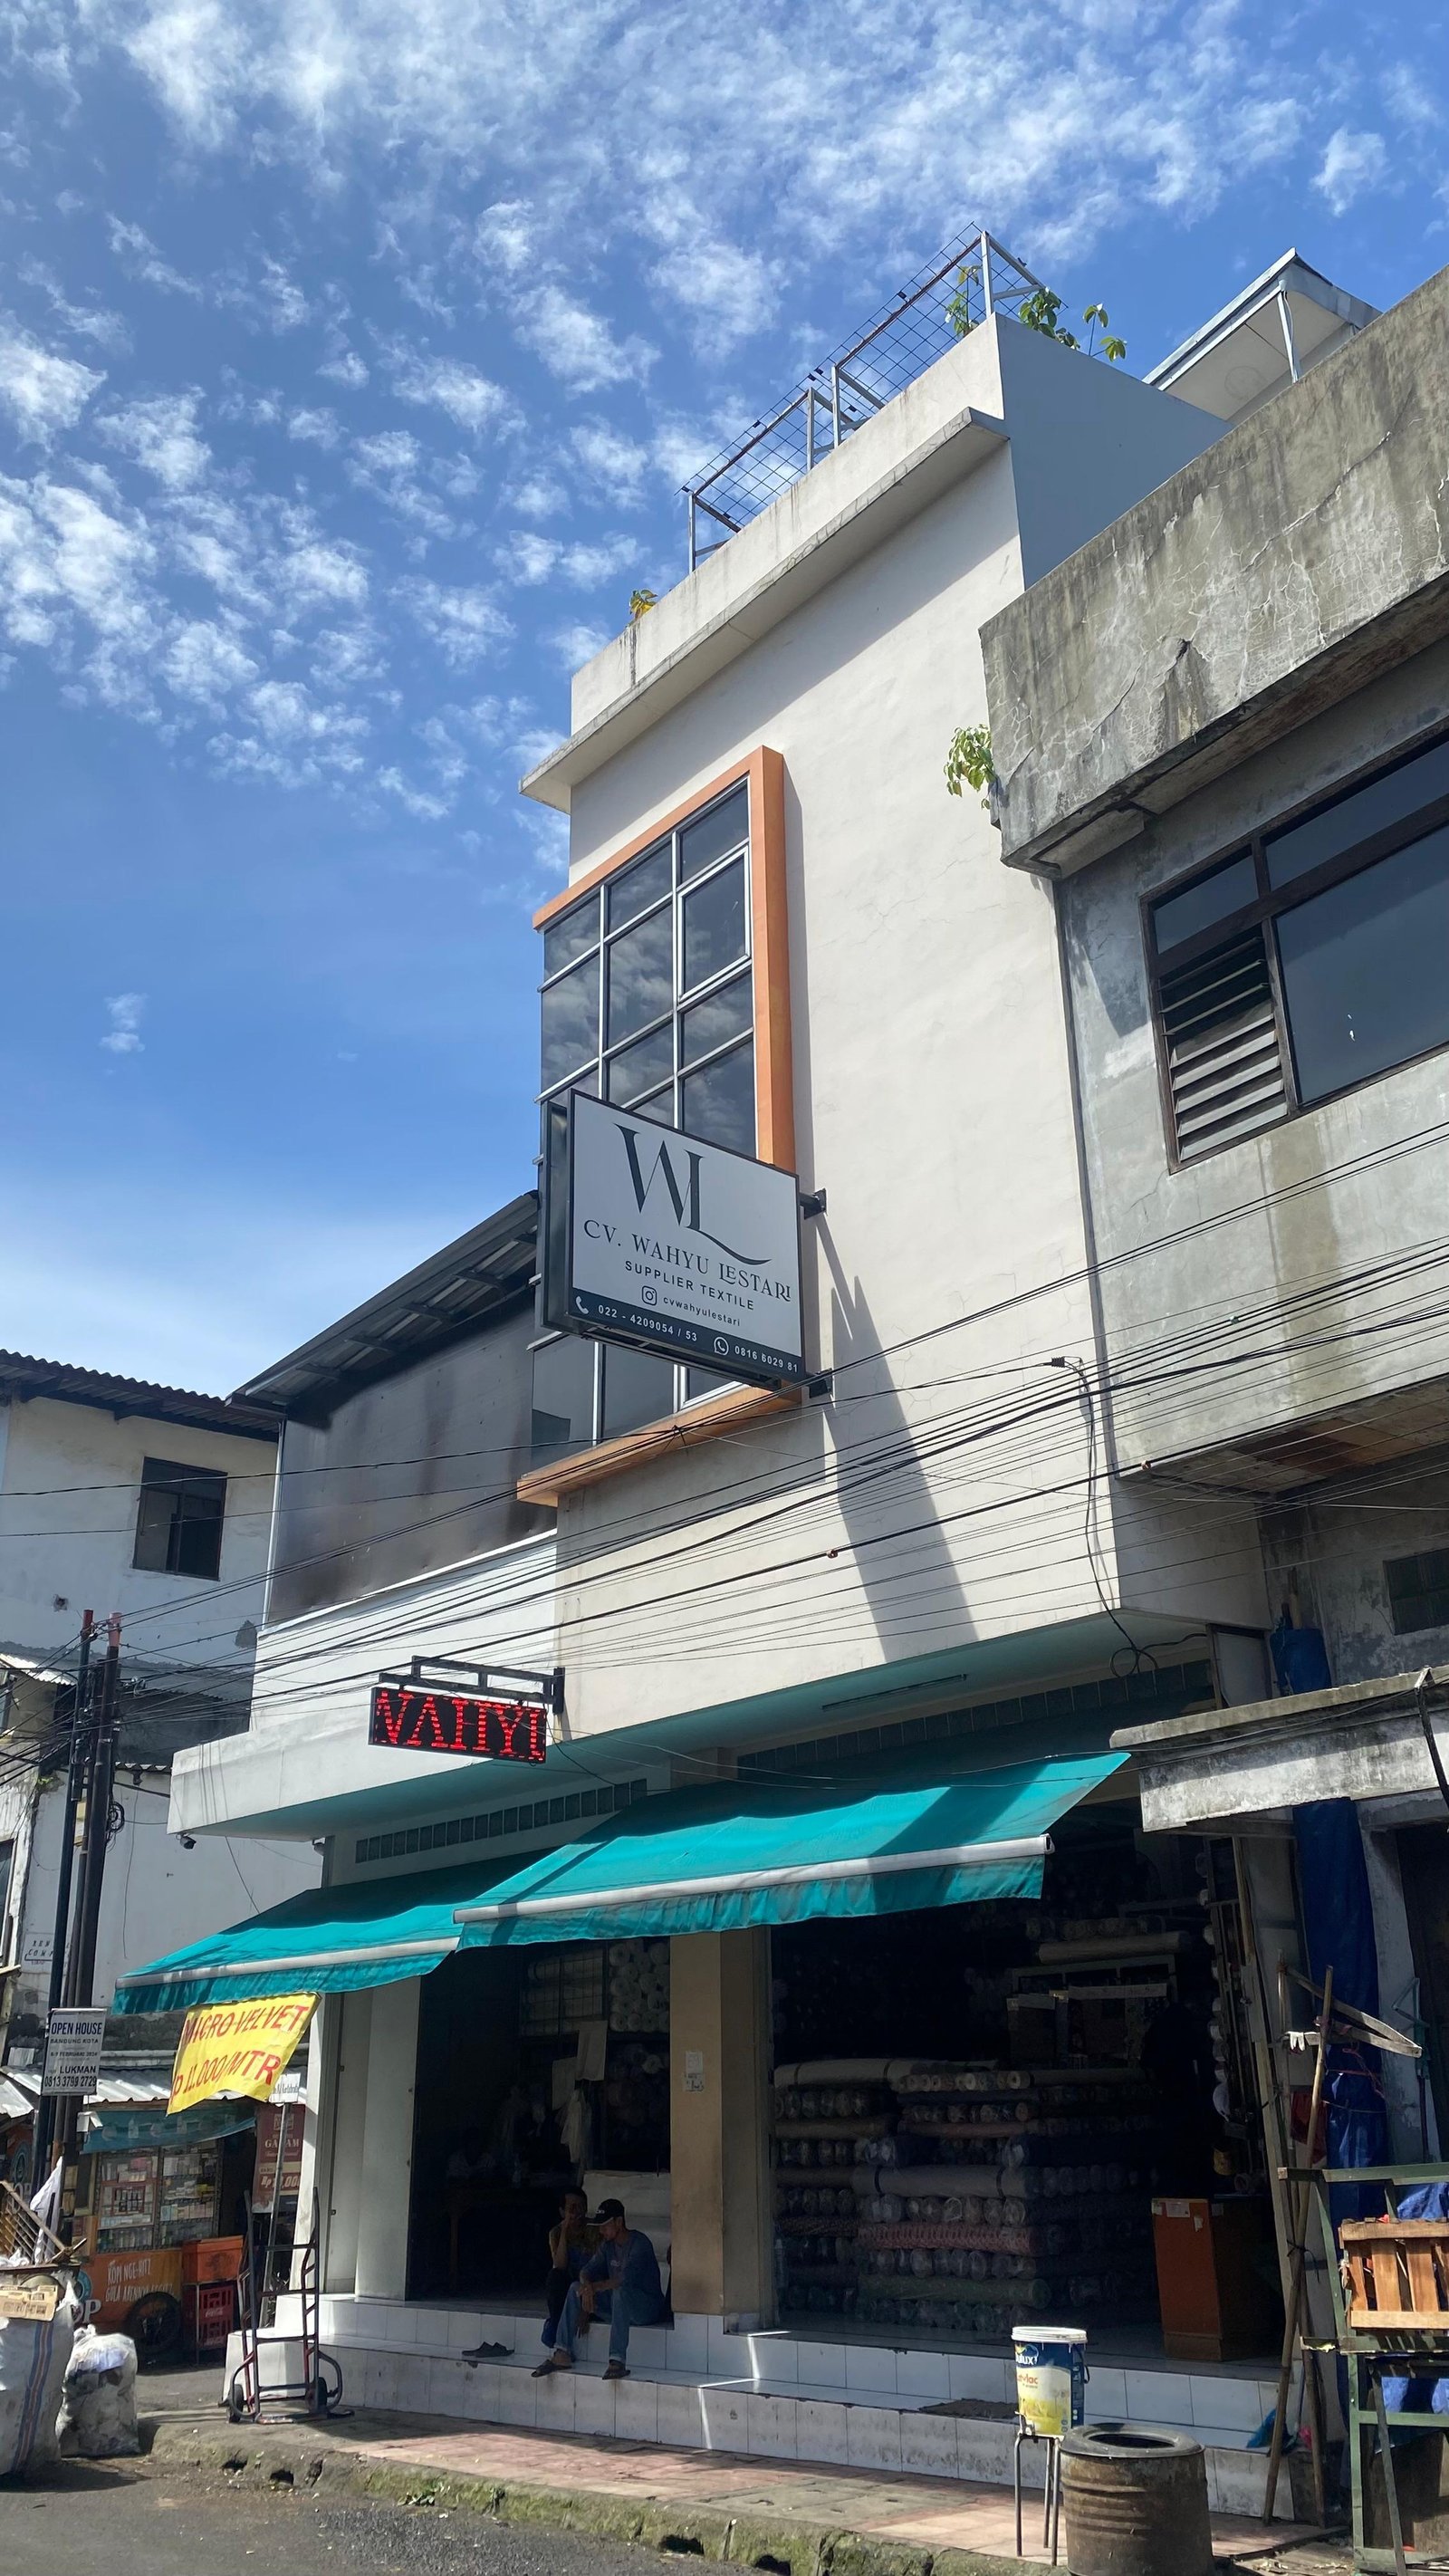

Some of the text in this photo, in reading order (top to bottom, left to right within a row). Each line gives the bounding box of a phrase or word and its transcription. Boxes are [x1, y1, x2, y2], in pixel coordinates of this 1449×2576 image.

[614, 1123, 772, 1265] WL
[583, 1219, 791, 1302] CV. WAHYU LESTARI
[625, 1260, 753, 1311] SUPPLIER TEXTILE
[598, 1304, 618, 1318] 022
[629, 1314, 674, 1334] 4209054
[686, 1330, 697, 1341] 53
[663, 1296, 740, 1326] cvwahyulestari
[734, 1345, 758, 1360] 0816
[787, 1361, 797, 1373] 81
[51, 2022, 102, 2035] OPEN HOUSE
[181, 2004, 310, 2045] MICRO VELVET
[44, 2075, 61, 2088] 0813
[80, 2075, 98, 2088] 2729
[59, 2065, 96, 2074] LUKMAN
[264, 2139, 300, 2148] GAAM
